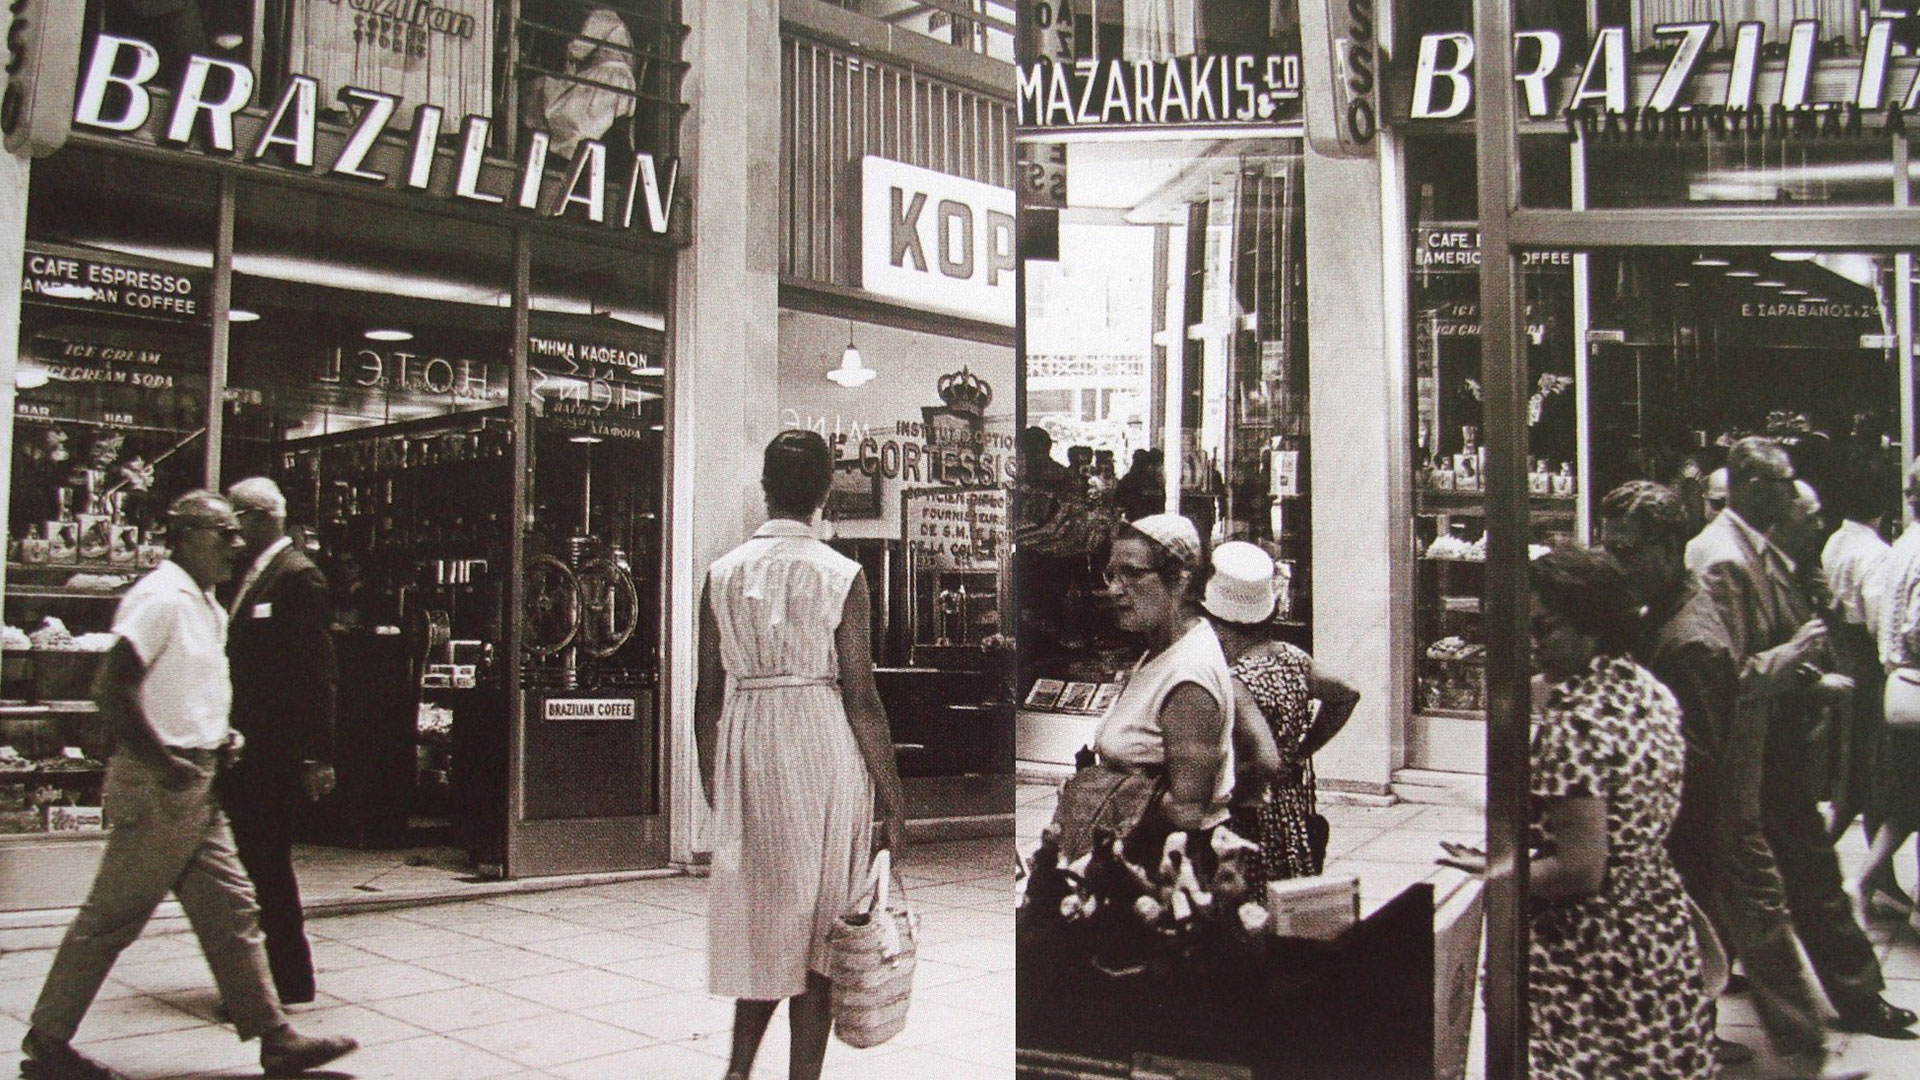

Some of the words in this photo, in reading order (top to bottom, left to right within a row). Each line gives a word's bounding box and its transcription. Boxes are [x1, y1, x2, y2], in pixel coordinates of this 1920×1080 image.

[1016, 56, 1256, 126] MAZARAKIS
[74, 33, 680, 234] BRAZILIAN
[1429, 233, 1469, 248] CAFE
[1424, 252, 1482, 265] AMERIC
[1522, 252, 1570, 265] OFFEE
[29, 256, 80, 280] CAFE
[89, 264, 192, 295] ESPRESSO
[125, 291, 196, 315] COFFEE
[19, 404, 50, 415] BAR
[598, 703, 632, 716] COFFEE
